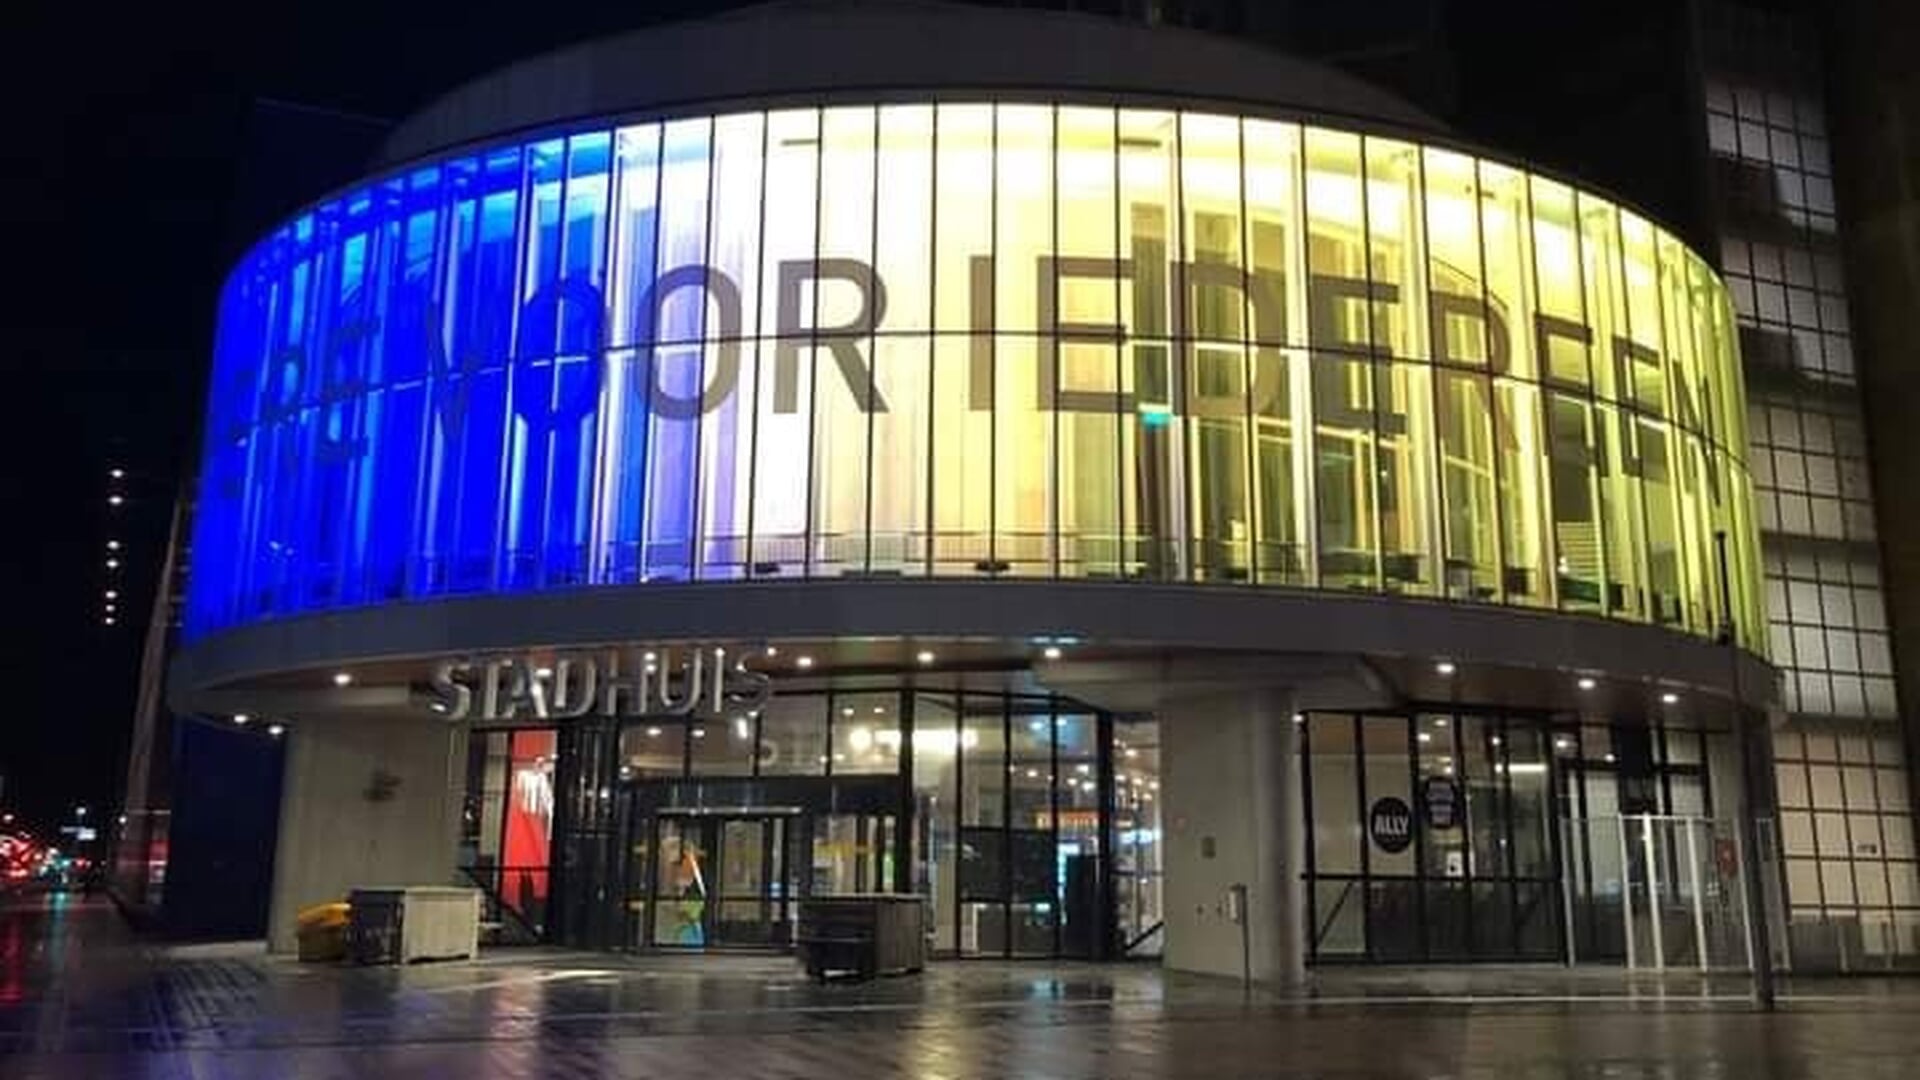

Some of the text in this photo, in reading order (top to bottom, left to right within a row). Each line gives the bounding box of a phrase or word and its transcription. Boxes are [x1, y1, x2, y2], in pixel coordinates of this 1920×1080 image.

[969, 254, 1722, 507] IEDEREEN
[431, 647, 769, 721] STADHUIS
[1374, 814, 1409, 835] ALLY
